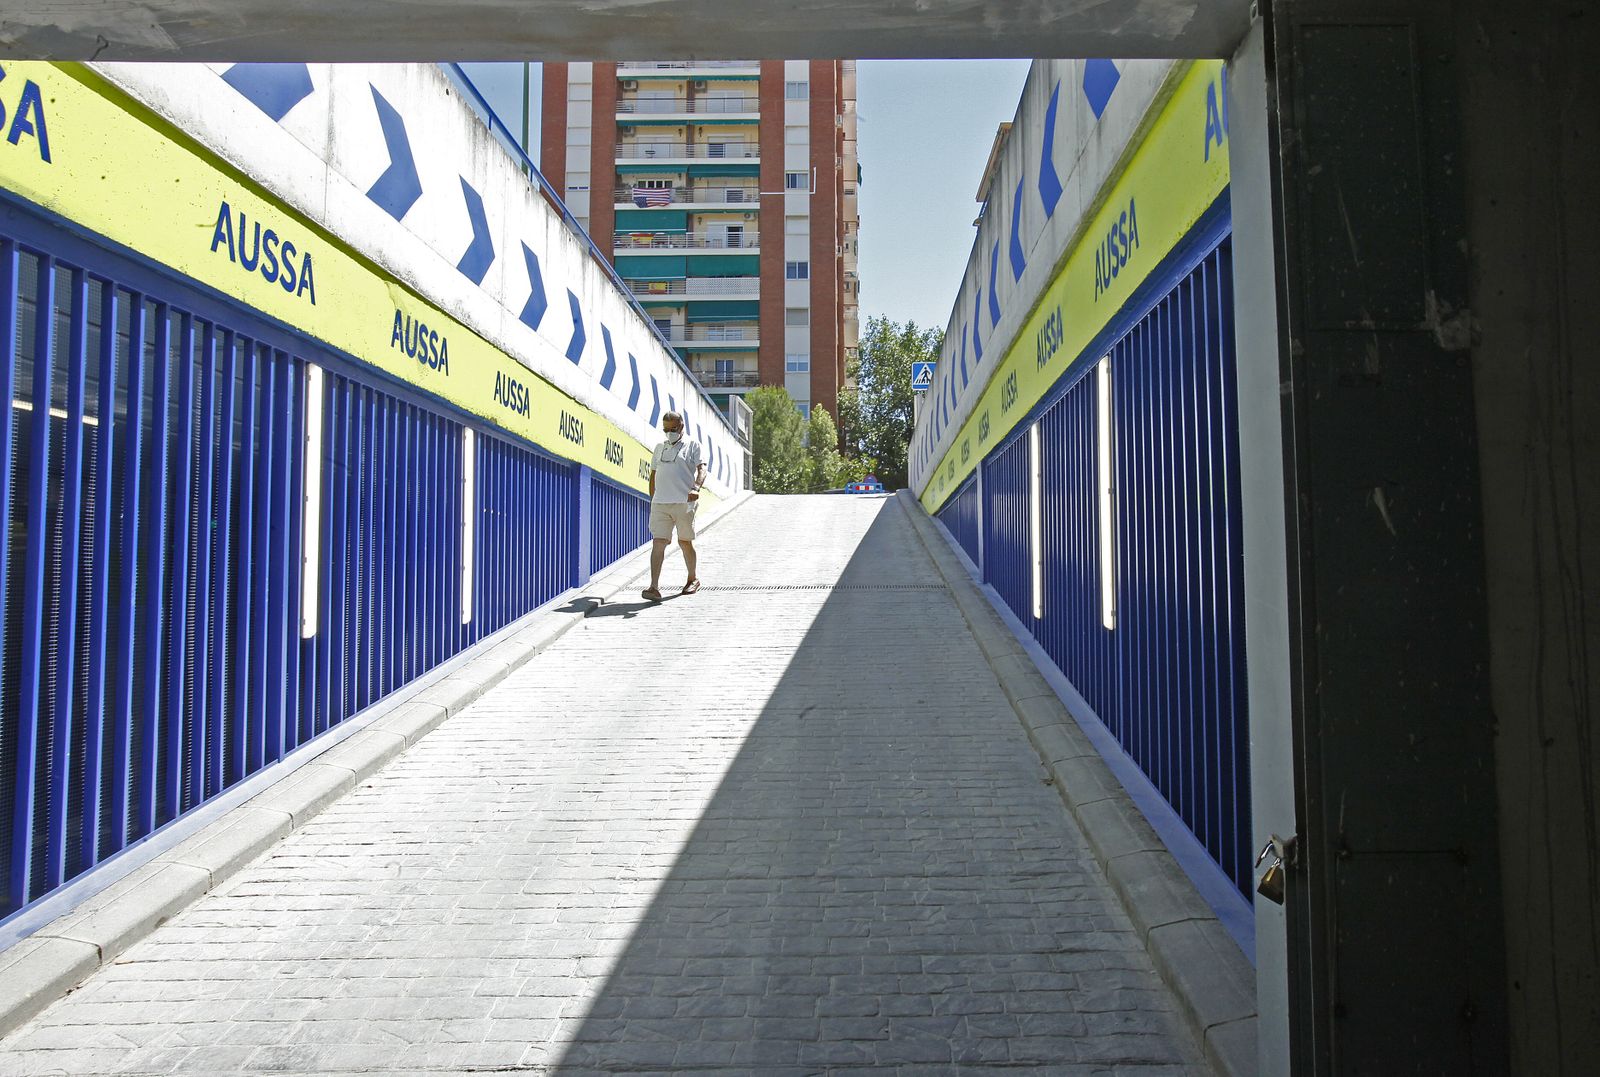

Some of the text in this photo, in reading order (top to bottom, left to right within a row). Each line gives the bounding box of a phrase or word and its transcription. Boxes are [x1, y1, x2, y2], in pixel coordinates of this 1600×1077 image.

[210, 200, 316, 305] AUSSA
[1095, 198, 1140, 302] AUSSA
[391, 309, 448, 375] AUSSA
[1037, 304, 1064, 370] AUSSA
[495, 371, 530, 417] AUSSA
[1001, 370, 1018, 414] AUSSA
[560, 409, 584, 446] AUSSA
[604, 437, 624, 468] AUSSA
